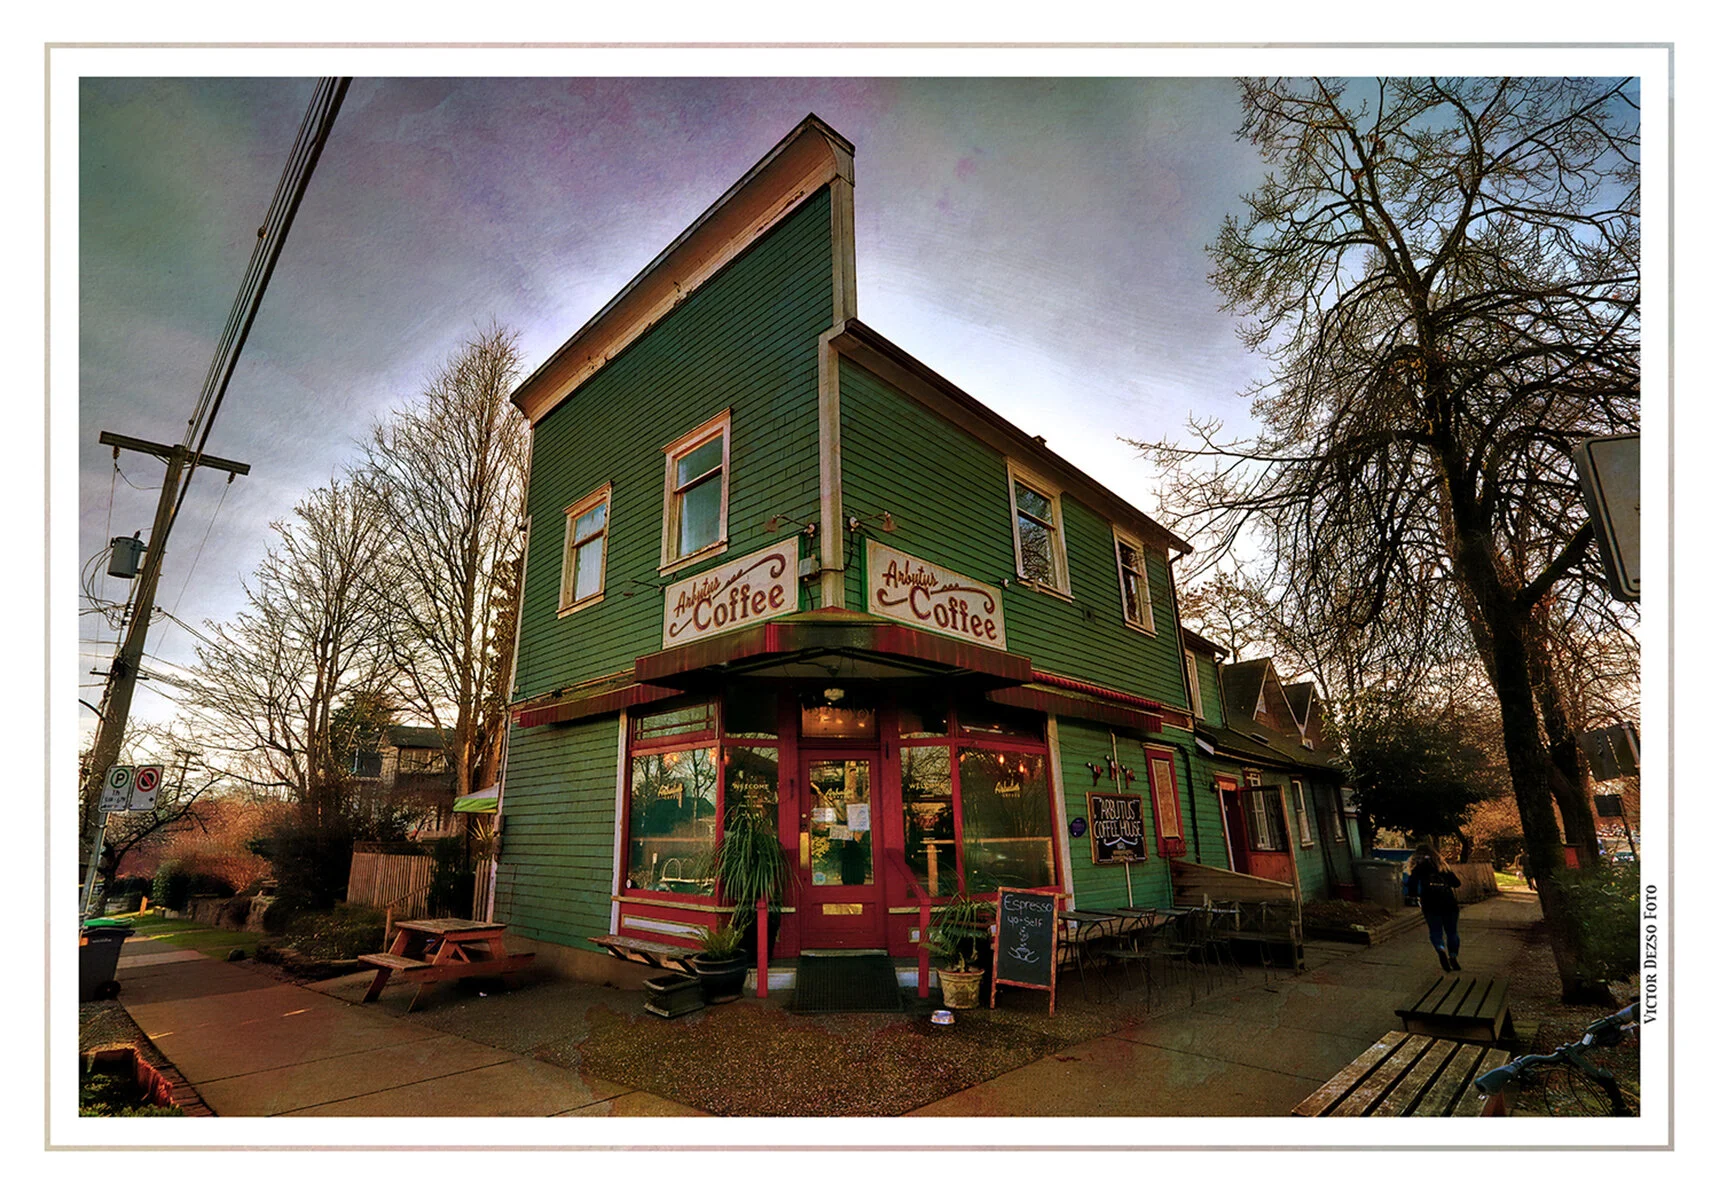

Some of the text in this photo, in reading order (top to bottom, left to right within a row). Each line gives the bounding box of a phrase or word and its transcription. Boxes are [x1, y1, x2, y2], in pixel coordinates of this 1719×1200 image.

[882, 560, 938, 588] Arbutus
[673, 577, 721, 618] Arbutus
[693, 583, 785, 632] Coffee
[909, 585, 998, 640] Coffee
[1101, 799, 1135, 820] ARBUTUS
[1094, 820, 1120, 838] COFFEE
[1120, 820, 1142, 837] HOUSE
[1004, 894, 1053, 915] Espresso
